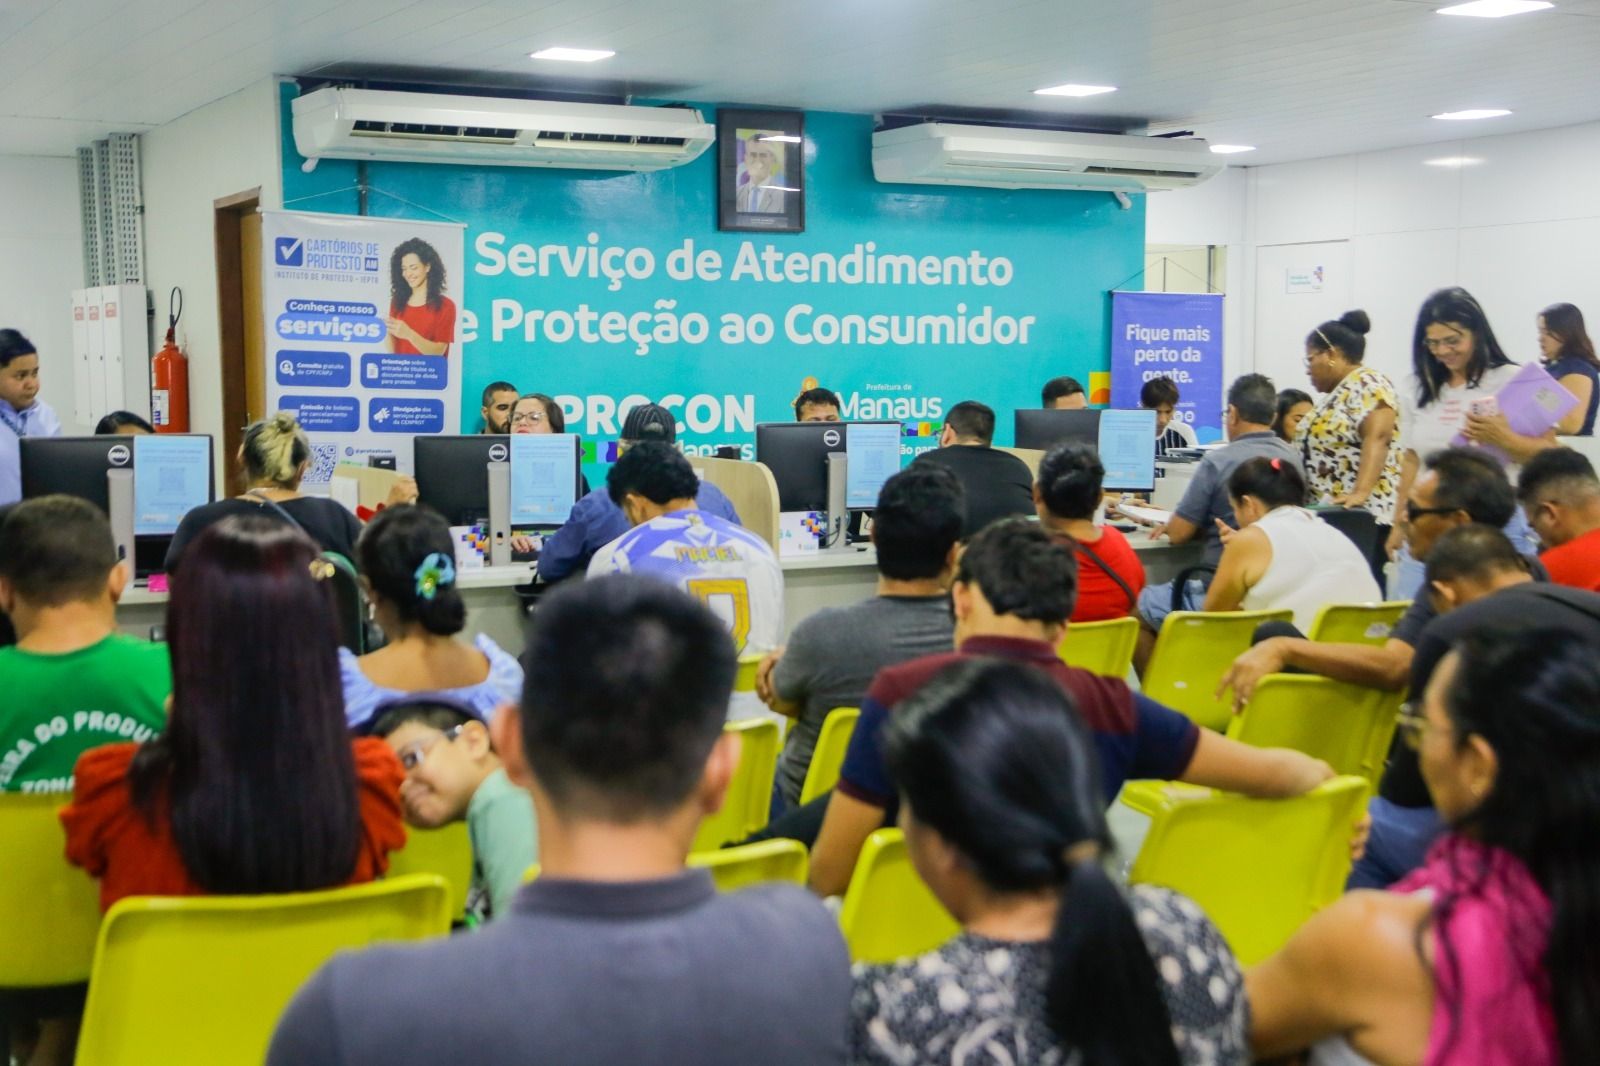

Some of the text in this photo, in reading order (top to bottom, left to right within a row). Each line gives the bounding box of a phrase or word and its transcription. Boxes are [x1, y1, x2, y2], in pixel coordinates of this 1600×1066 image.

[306, 238, 380, 256] CARTÓRIOS DE
[306, 253, 362, 271] PROTESTO
[474, 232, 1014, 292] Serviço de Atendimento
[289, 301, 375, 315] Conheça nossos
[279, 316, 381, 341] serviços
[491, 299, 710, 356] Proteção
[719, 312, 775, 344] ao
[784, 303, 1036, 345] Consumidor
[1126, 323, 1211, 344] Fique mais
[1134, 346, 1202, 366] perto da
[866, 383, 901, 391] Prefeitura
[835, 391, 943, 420] Manaus
[34, 716, 69, 745] DO
[73, 710, 160, 744] PRODU
